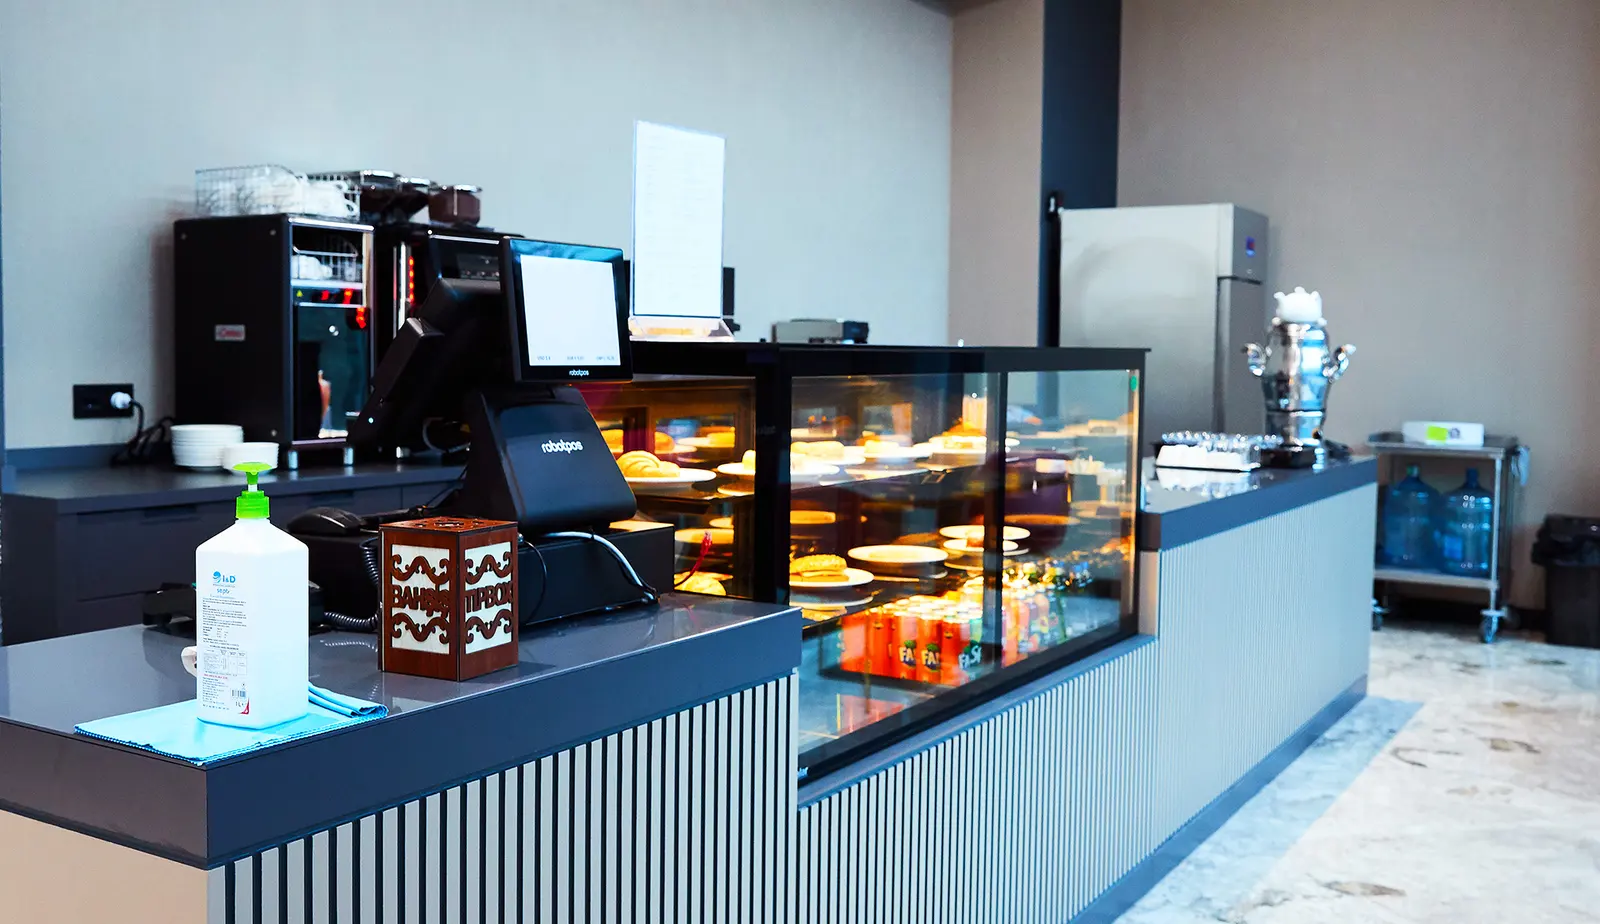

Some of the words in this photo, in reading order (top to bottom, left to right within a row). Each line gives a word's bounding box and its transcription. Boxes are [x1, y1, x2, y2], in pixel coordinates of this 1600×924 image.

[569, 369, 589, 377] robotpos
[541, 439, 583, 454] robotpos
[464, 581, 513, 614] TIPBOX
